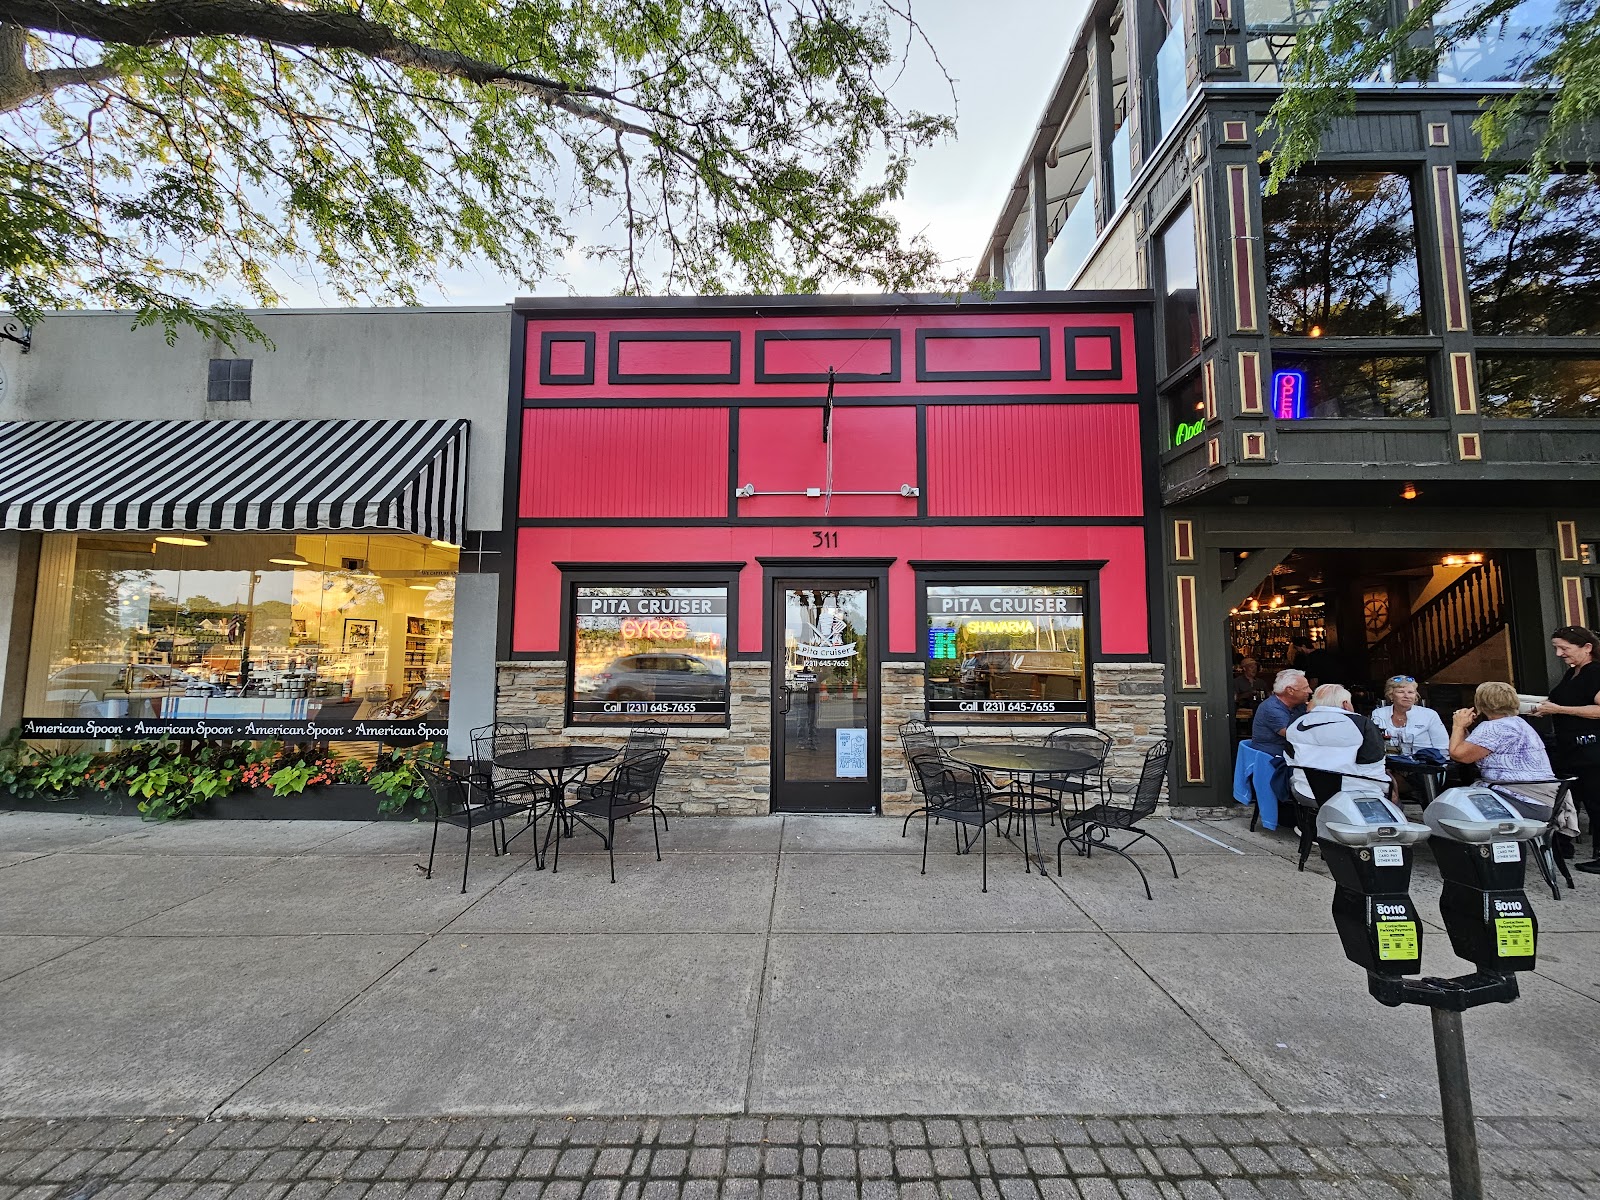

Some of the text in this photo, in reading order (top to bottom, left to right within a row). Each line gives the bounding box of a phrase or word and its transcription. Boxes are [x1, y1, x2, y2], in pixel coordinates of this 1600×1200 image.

[1281, 375, 1296, 419] OPEN
[812, 531, 838, 548] 311
[591, 599, 712, 614] PITA CRUISER
[942, 598, 1067, 613] PITA CRUISER
[621, 620, 687, 639] GYROS
[967, 620, 1035, 635] SHAWARMA
[603, 702, 696, 713] Call (231) 645-7655
[959, 702, 1056, 712] Call (231) 645-7655
[25, 720, 120, 738] American Spoon
[135, 721, 231, 739] American Spoon
[245, 722, 342, 739] American Spoon
[355, 722, 417, 736] American
[1377, 904, 1406, 915] 80110
[1494, 901, 1522, 911] 80110
